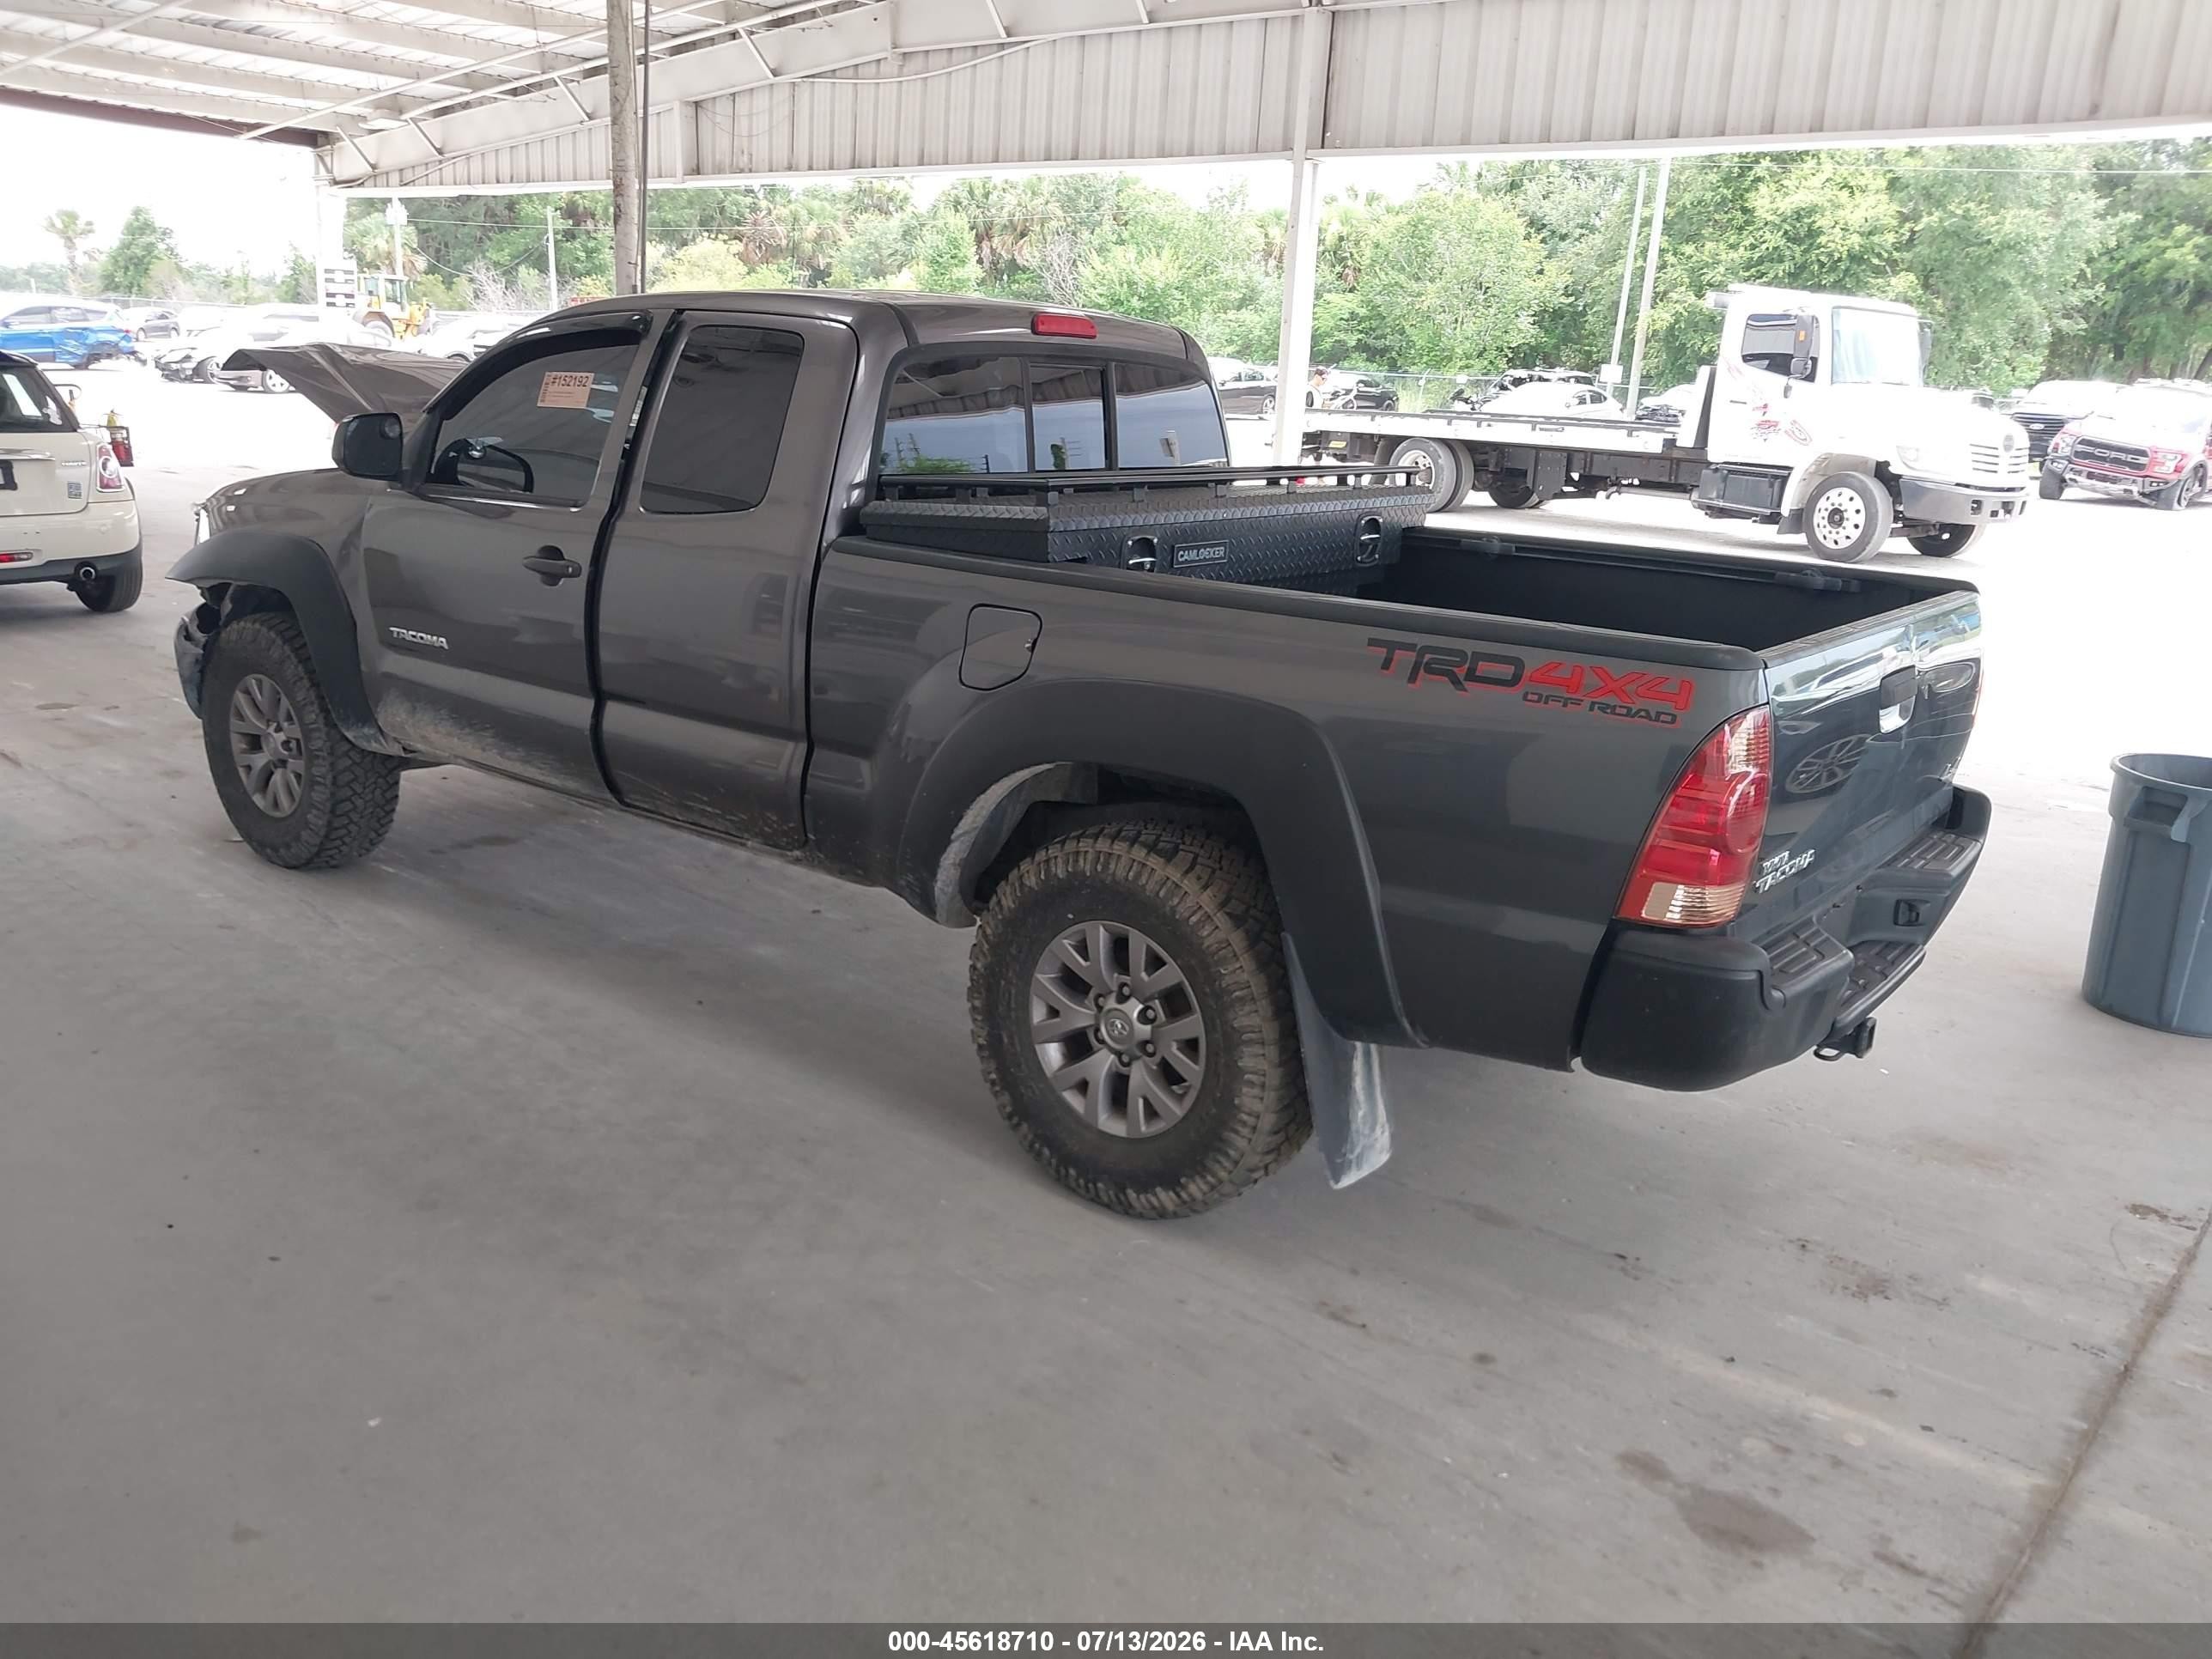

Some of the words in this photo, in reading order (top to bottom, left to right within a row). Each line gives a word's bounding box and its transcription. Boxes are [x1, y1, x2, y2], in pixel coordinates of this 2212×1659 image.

[2074, 444, 2149, 465] FORD
[389, 627, 449, 649] TACOMA
[1367, 637, 1526, 694] TRD
[1522, 690, 1584, 708] OFF
[1588, 700, 1679, 726] ROAD
